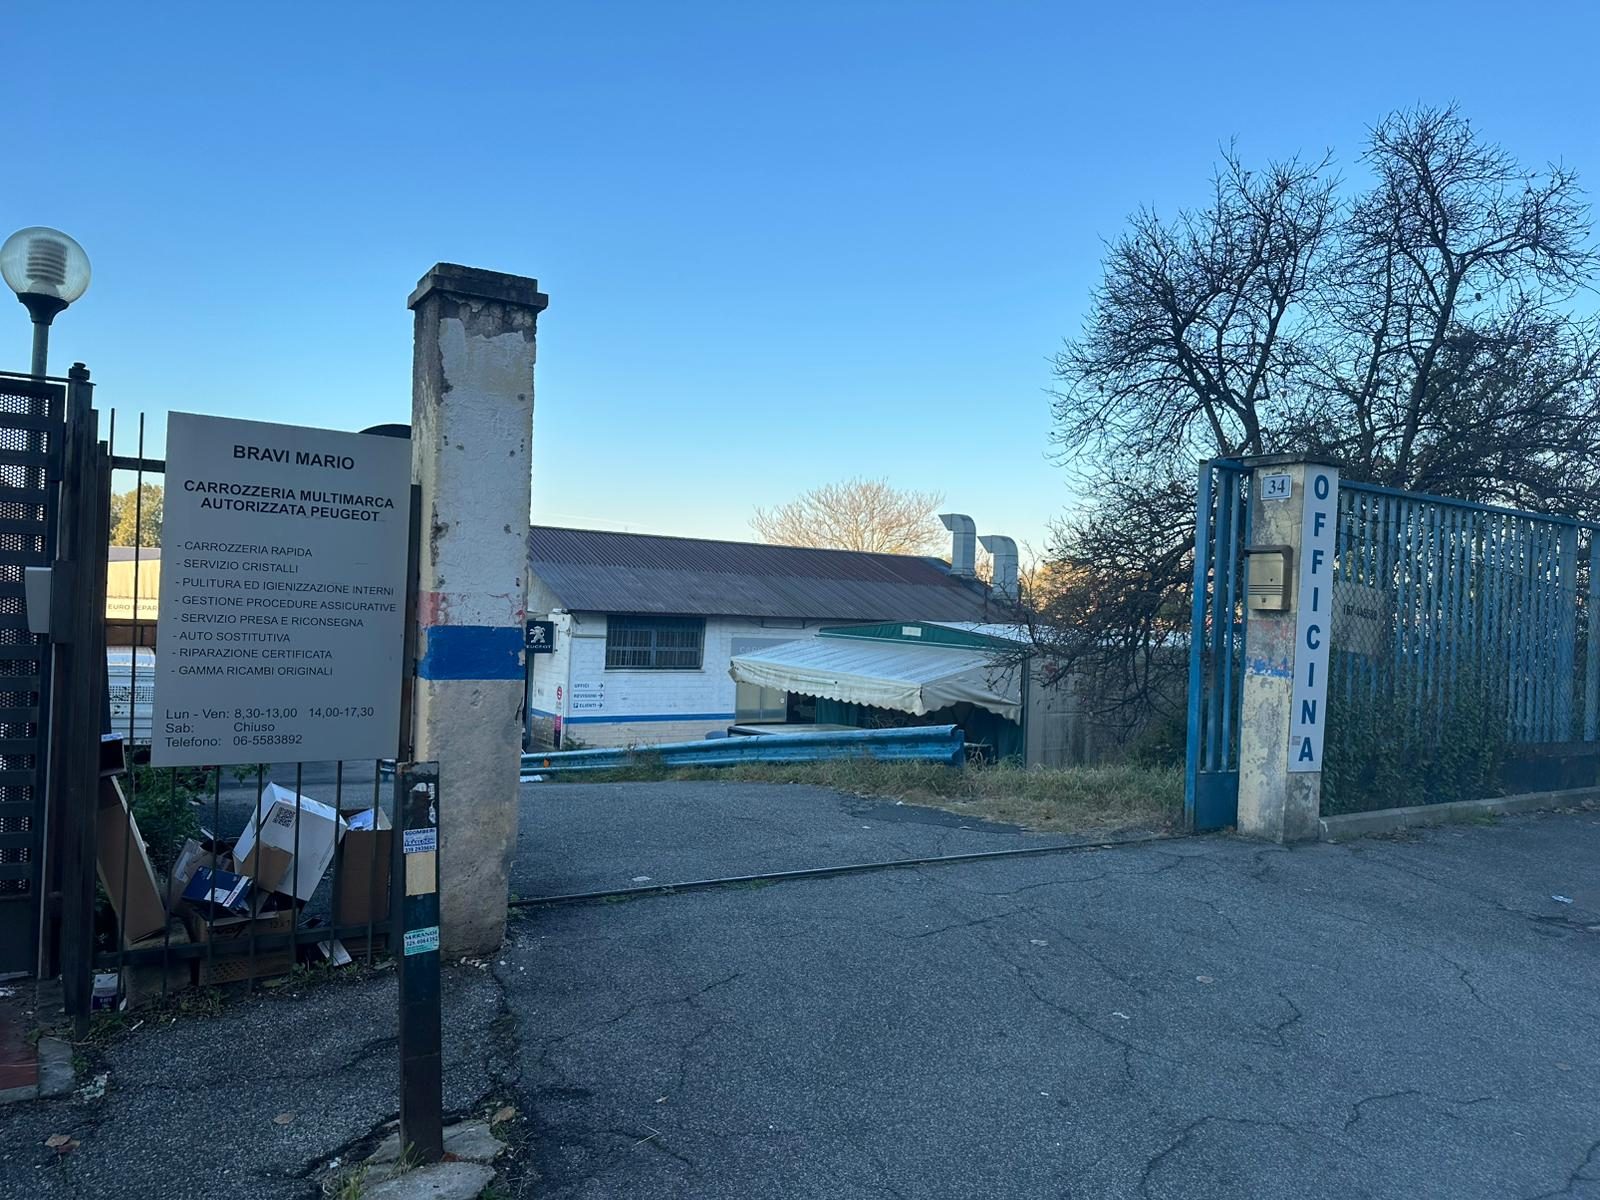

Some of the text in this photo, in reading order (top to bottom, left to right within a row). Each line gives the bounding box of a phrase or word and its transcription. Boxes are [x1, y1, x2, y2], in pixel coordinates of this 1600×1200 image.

[233, 445, 354, 470] BRAVI MARIO
[184, 480, 394, 509] CARROZZERIA MULTIMARCA
[1268, 479, 1285, 495] 34
[200, 497, 381, 522] AUTORIZZATA PEUGEOT
[184, 541, 269, 555] CARROZZERIA
[270, 546, 312, 558] RAPIDA
[183, 558, 239, 571] SERVIZIO
[242, 561, 298, 574] CRISTALLI
[183, 577, 241, 589] PULITURA
[243, 580, 260, 590] ED
[263, 581, 350, 594] IGIENIZZAZIONE
[352, 585, 394, 597] INTERNI
[182, 595, 244, 607] GESTIONE
[246, 598, 318, 610] PROCEDURE
[319, 601, 397, 613] ASSICURATIVE
[181, 613, 237, 625] SERVIZIO
[239, 615, 279, 626] PRESA
[280, 616, 289, 626] E
[291, 616, 364, 628] RICONSEGNA
[1298, 474, 1330, 762] OFFICINA
[178, 631, 213, 642] AUTO
[216, 631, 290, 643] SOSTITUTIVA
[180, 647, 259, 659] RIPARAZIONE
[261, 648, 332, 660] CERTIFICATA
[178, 665, 224, 676] GAMMA
[226, 665, 275, 676] RICAMBI
[277, 666, 332, 676] ORIGINALI
[165, 709, 190, 720] Lun
[202, 708, 231, 719] Ven:
[164, 721, 276, 734] Sab: Chiuso
[164, 734, 302, 748] Telefono: 06-5583892
